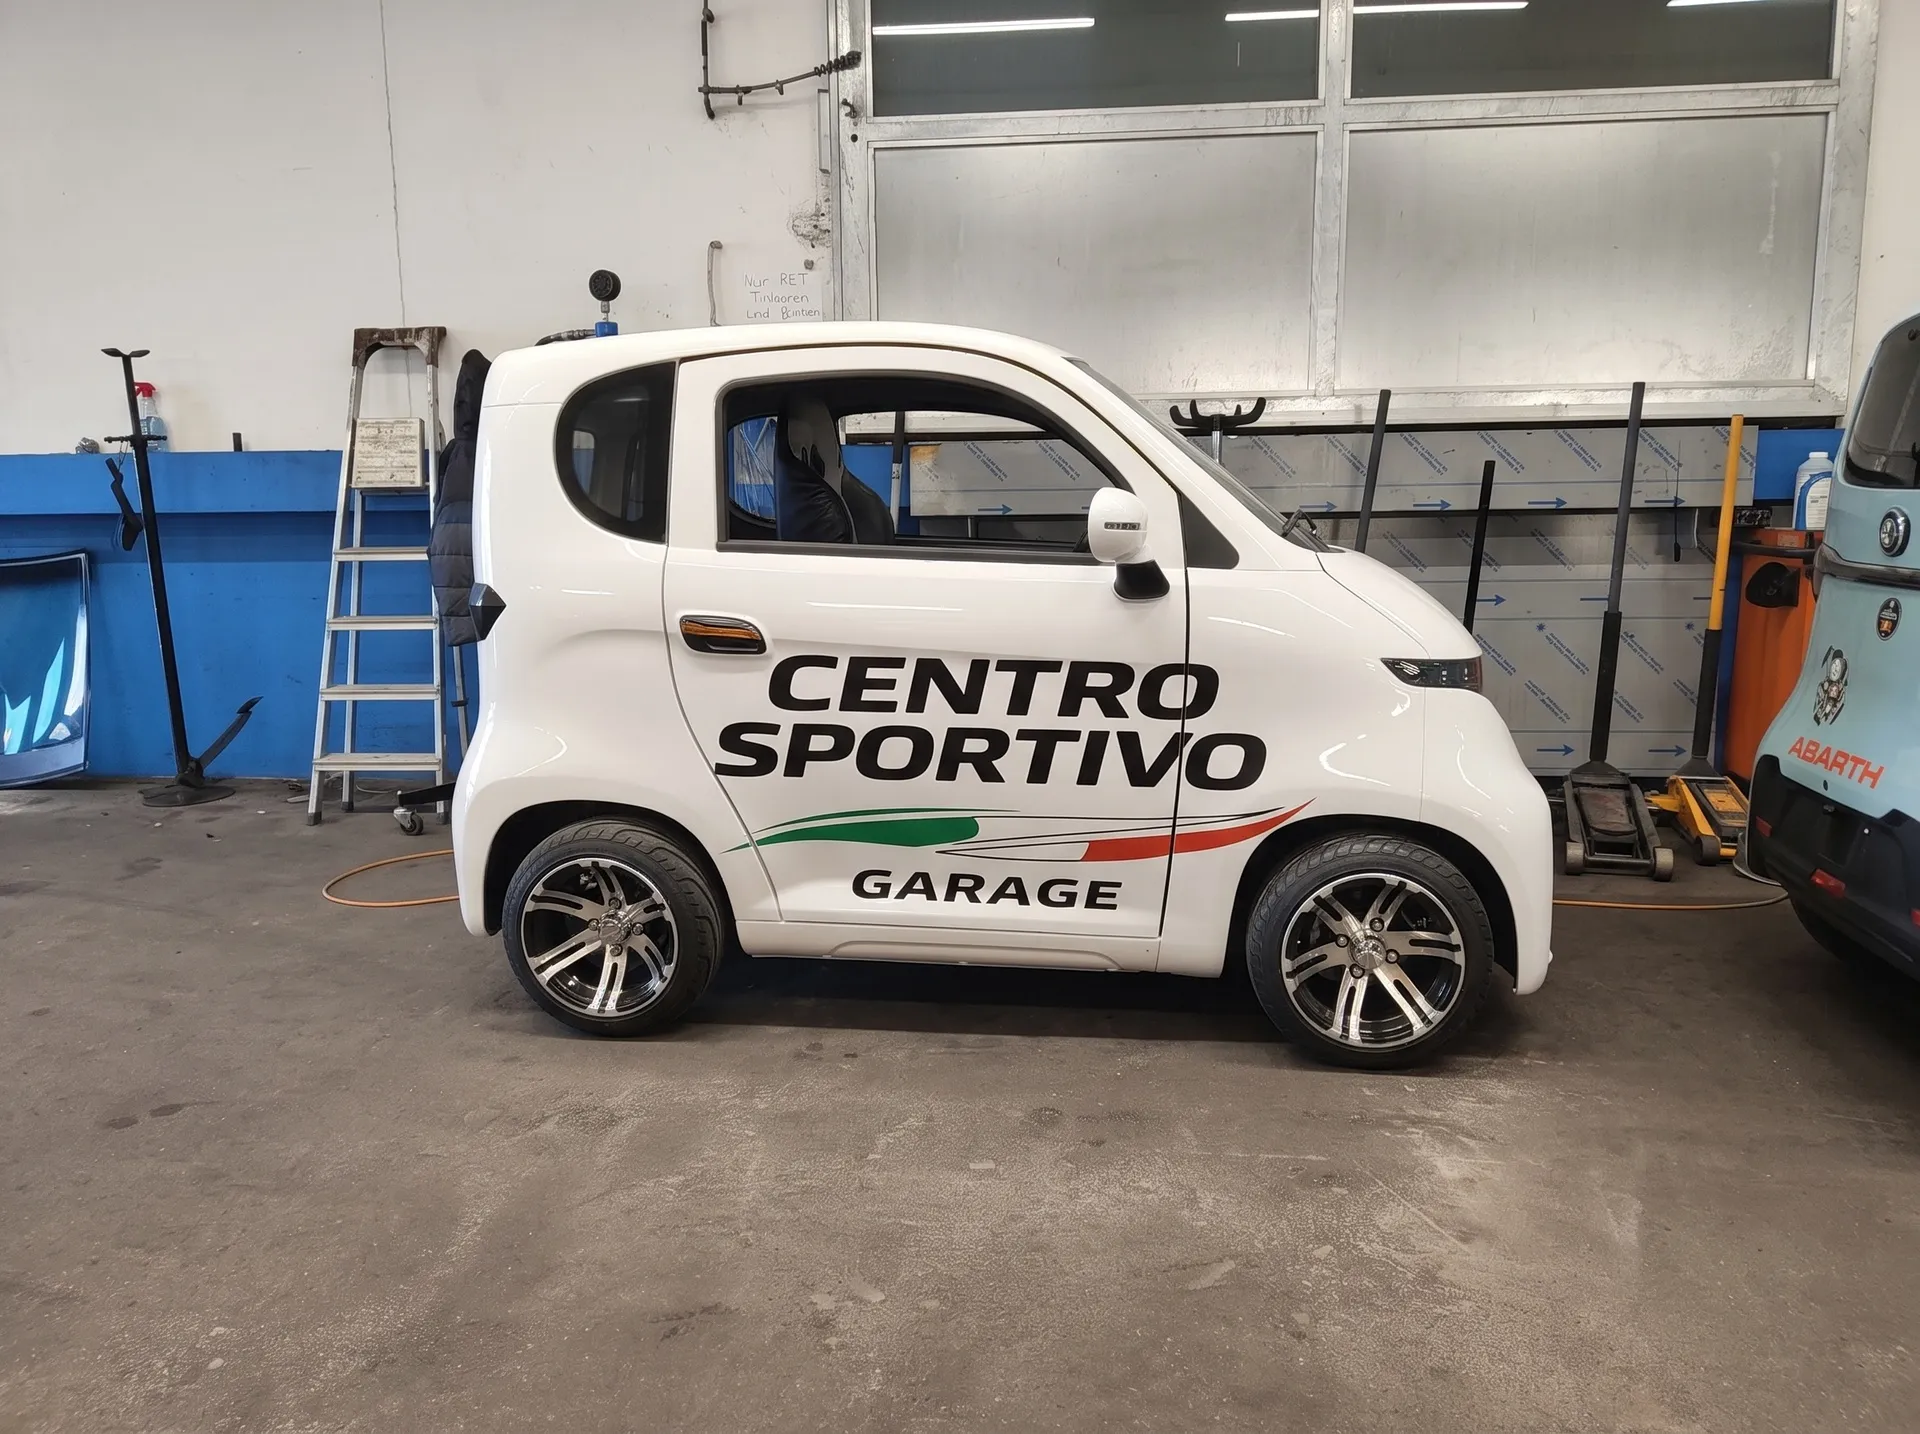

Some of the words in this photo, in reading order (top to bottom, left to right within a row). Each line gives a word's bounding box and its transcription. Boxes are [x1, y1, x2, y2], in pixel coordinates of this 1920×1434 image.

[744, 273, 769, 288] Nur
[780, 272, 808, 286] RET
[768, 654, 1219, 720] CENTRO
[715, 722, 1267, 791] SPORTIVO
[1788, 736, 1885, 789] ABARTH
[852, 869, 1122, 910] GARAGE
